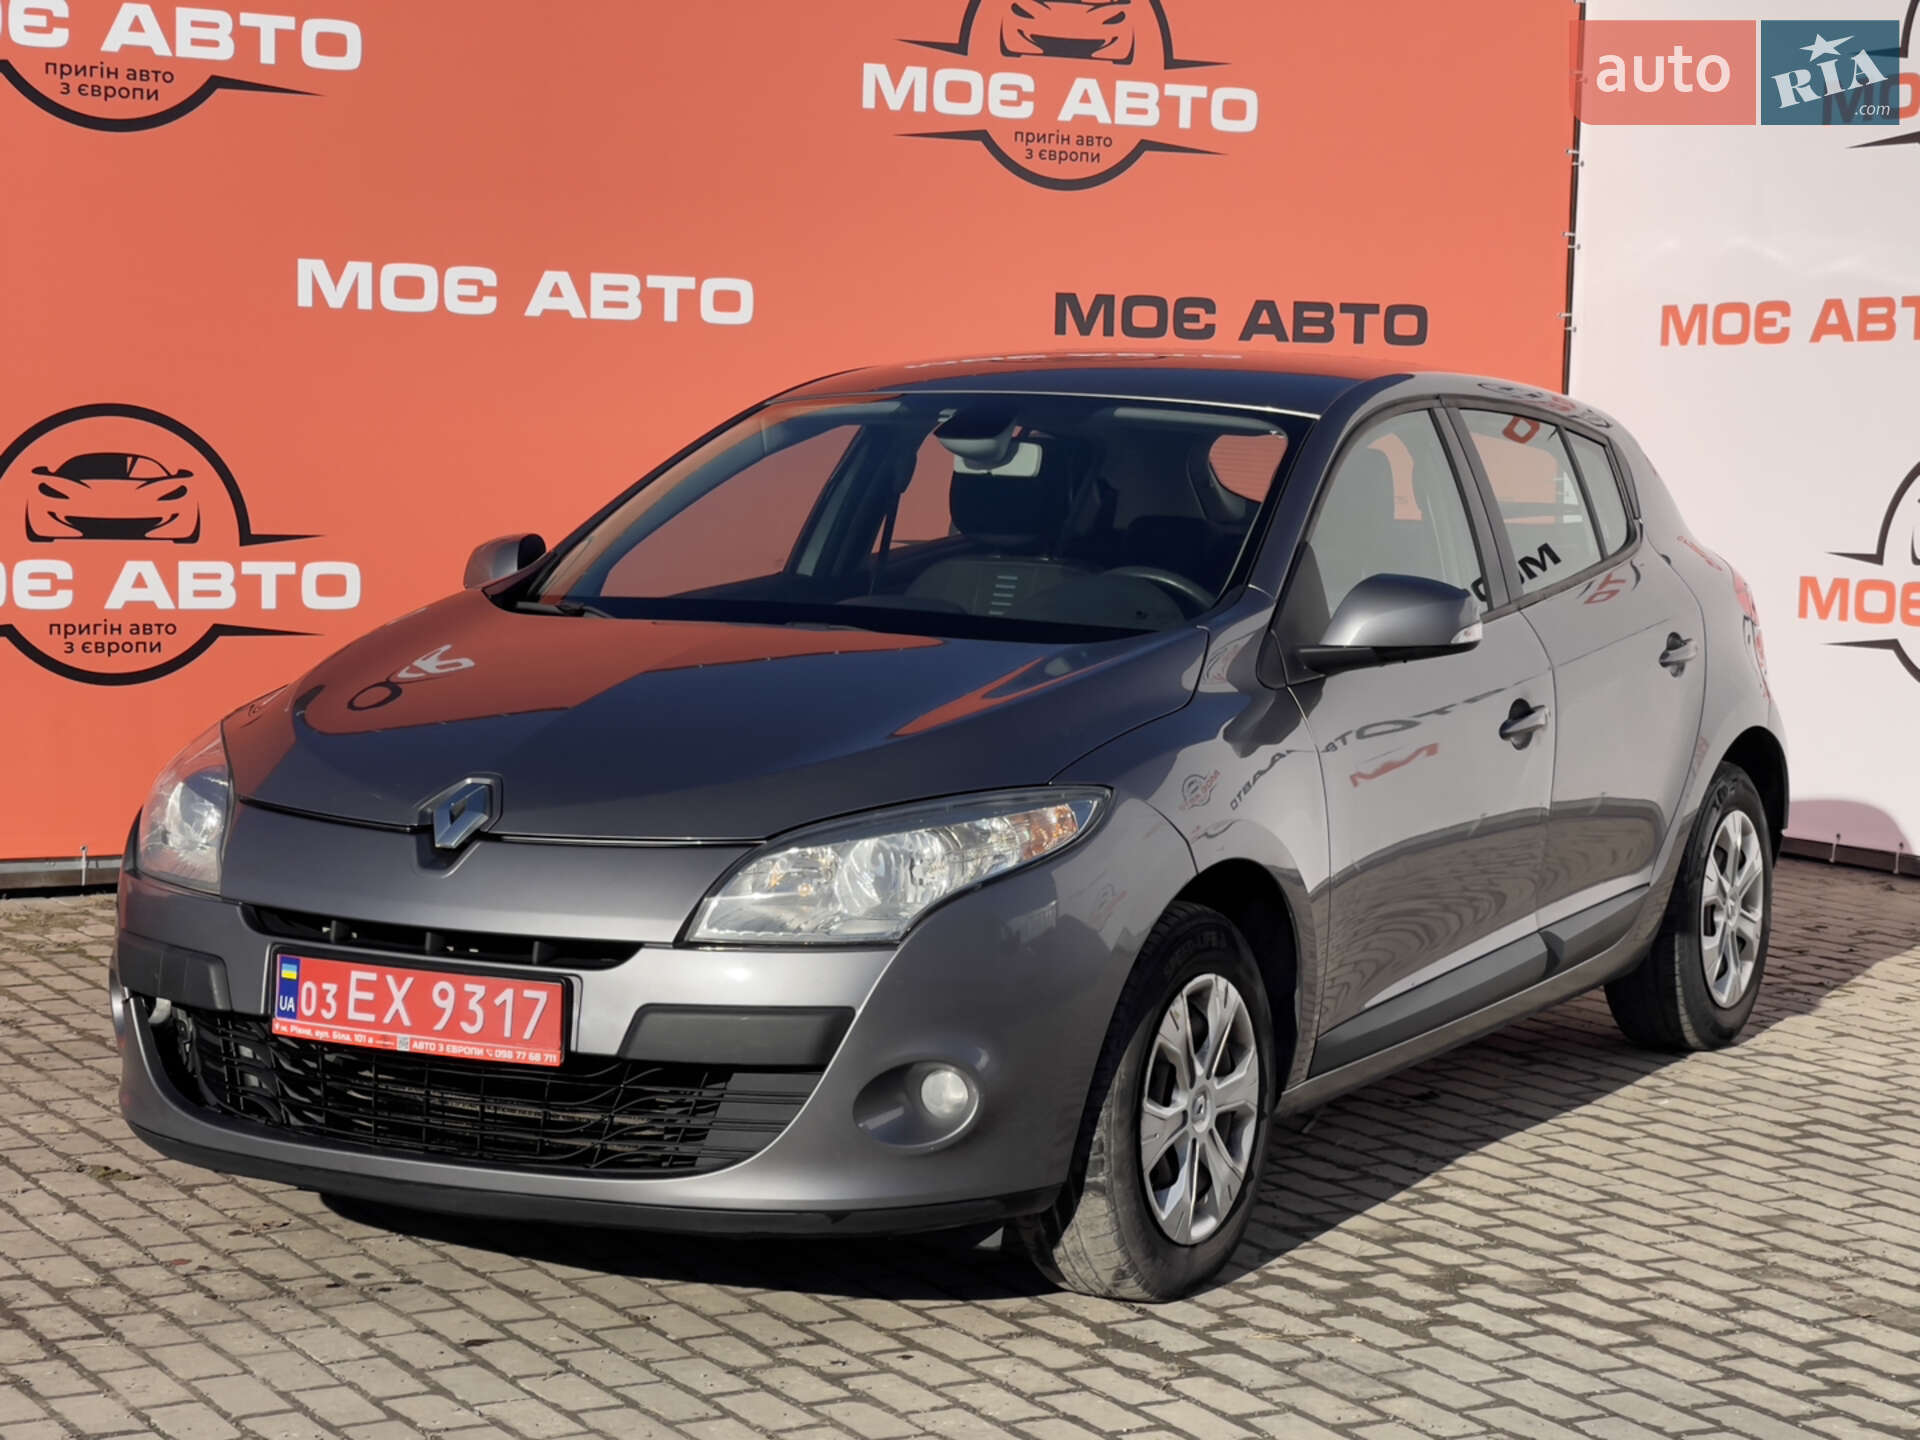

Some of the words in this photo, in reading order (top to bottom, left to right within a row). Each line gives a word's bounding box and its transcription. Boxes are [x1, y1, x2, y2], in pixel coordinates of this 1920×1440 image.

[0, 0, 69, 48] Є
[100, 2, 362, 71] АВТО
[45, 61, 118, 79] пригін
[126, 68, 174, 83] авто
[60, 82, 70, 95] з
[78, 84, 159, 101] європи
[862, 63, 1035, 119] МОЄ
[1057, 77, 1258, 133] АВТО
[1014, 129, 1070, 145] пригін
[1076, 135, 1113, 147] авто
[1025, 148, 1033, 159] з
[1039, 149, 1100, 164] європи
[297, 258, 497, 315] МОЄ
[524, 270, 754, 325] АВТО
[1055, 292, 1216, 340] МОЄ
[1238, 299, 1428, 346] АВТО
[1660, 300, 1791, 346] МОЄ
[0, 559, 73, 610] Є
[104, 560, 361, 610] АВТО
[49, 619, 122, 638] пригін
[129, 622, 177, 636] авто
[64, 641, 74, 654] з
[81, 641, 162, 657] європи
[279, 996, 295, 1013] UA
[301, 981, 338, 1020] 03
[347, 970, 414, 1027] EX
[432, 981, 547, 1040] 9317
[412, 1040, 436, 1051] АВТО
